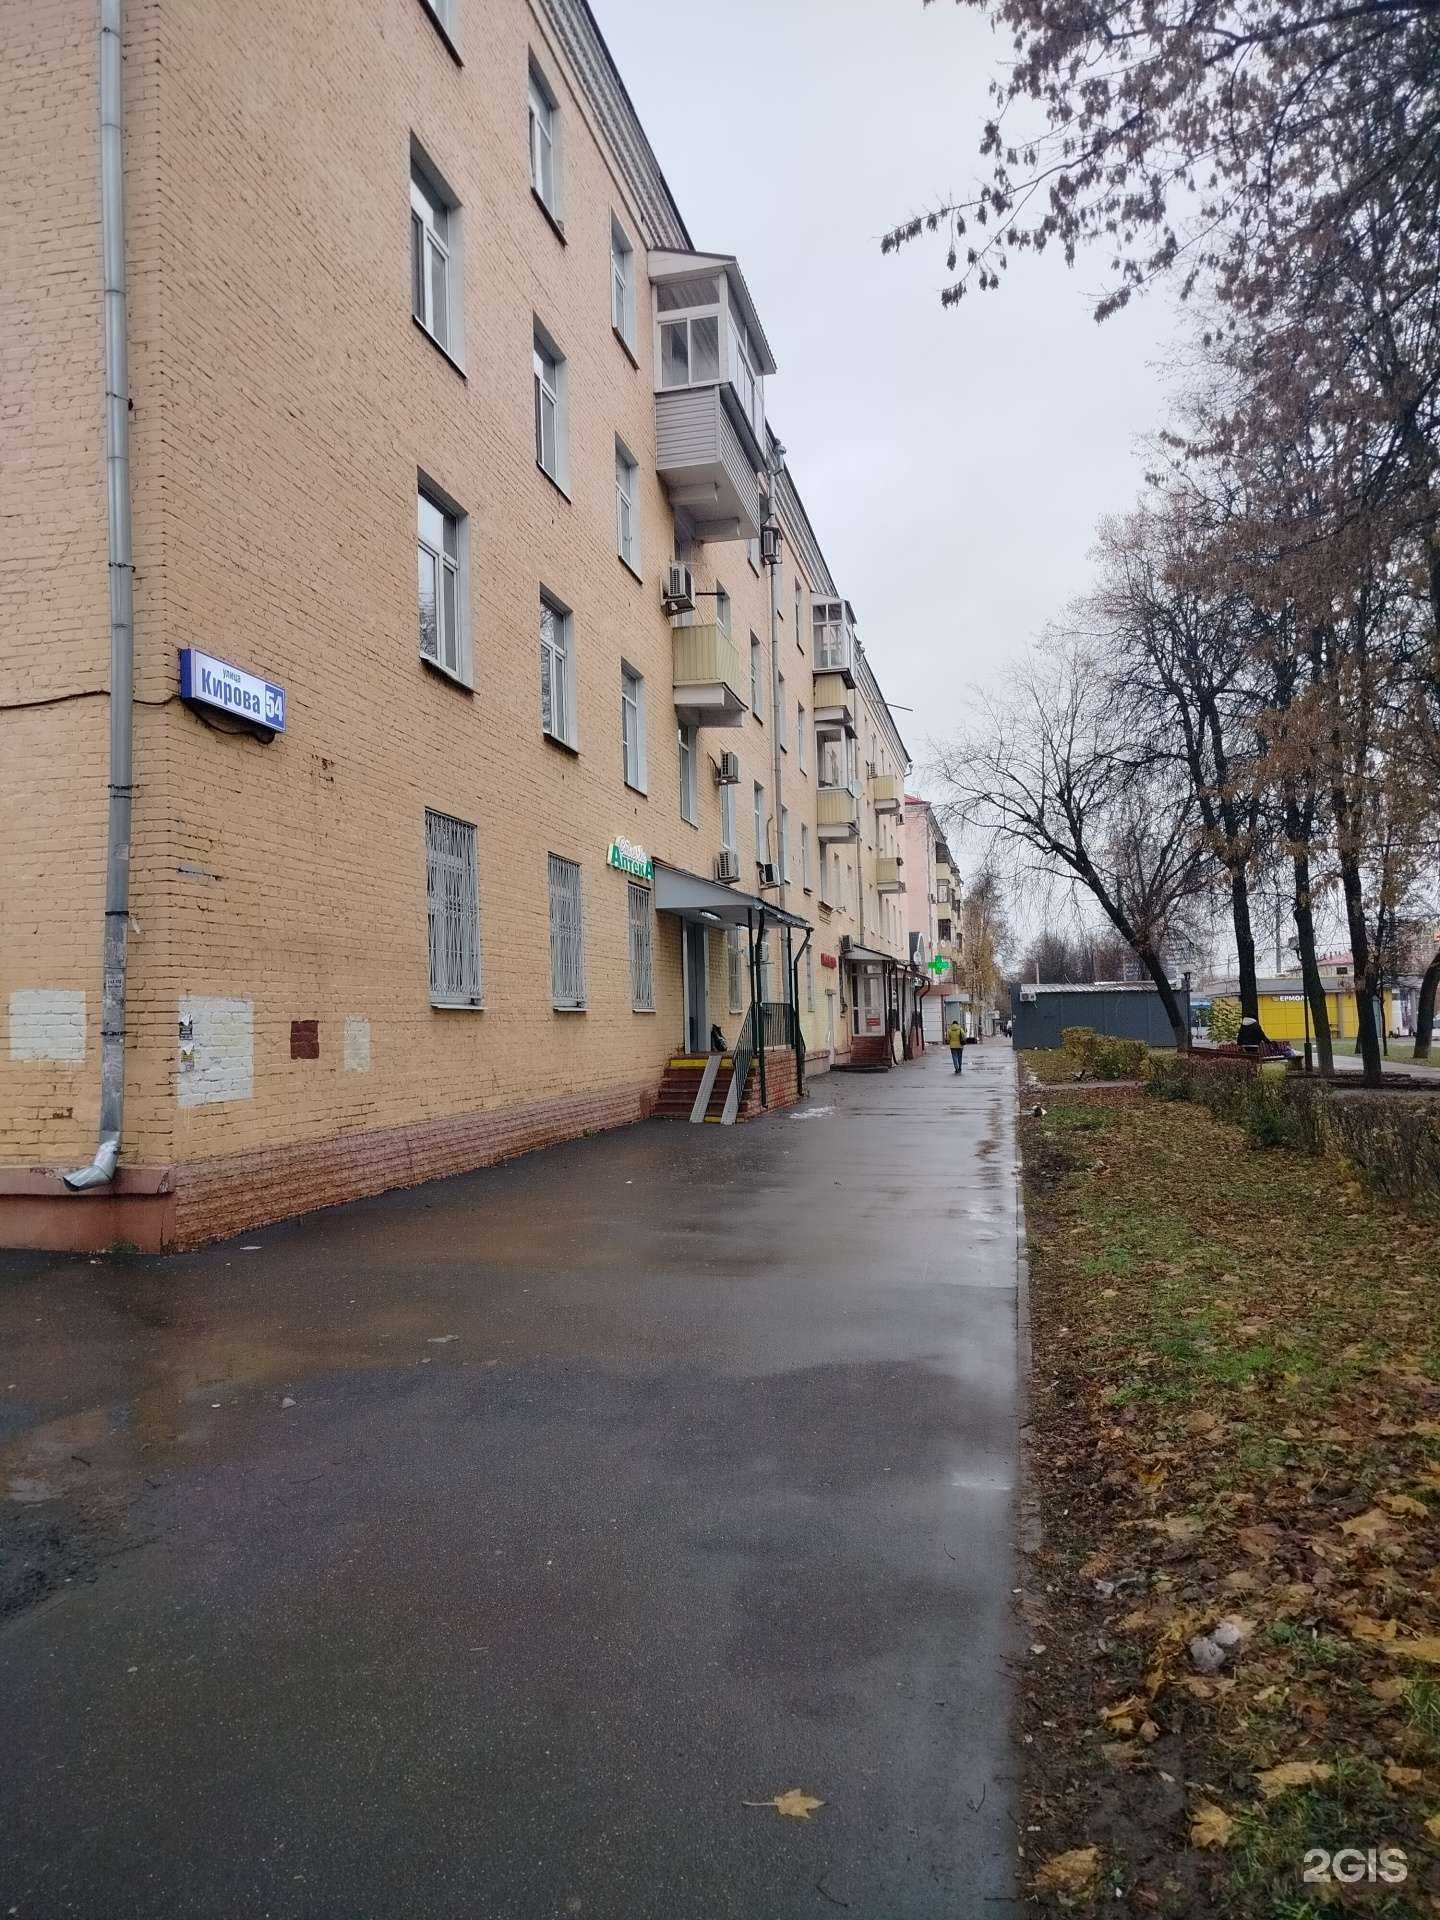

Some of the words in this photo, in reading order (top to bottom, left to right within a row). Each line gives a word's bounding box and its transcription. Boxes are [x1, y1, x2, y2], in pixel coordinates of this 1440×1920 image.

[222, 668, 241, 683] улица
[201, 668, 261, 714] Кирова
[265, 690, 284, 722] 54
